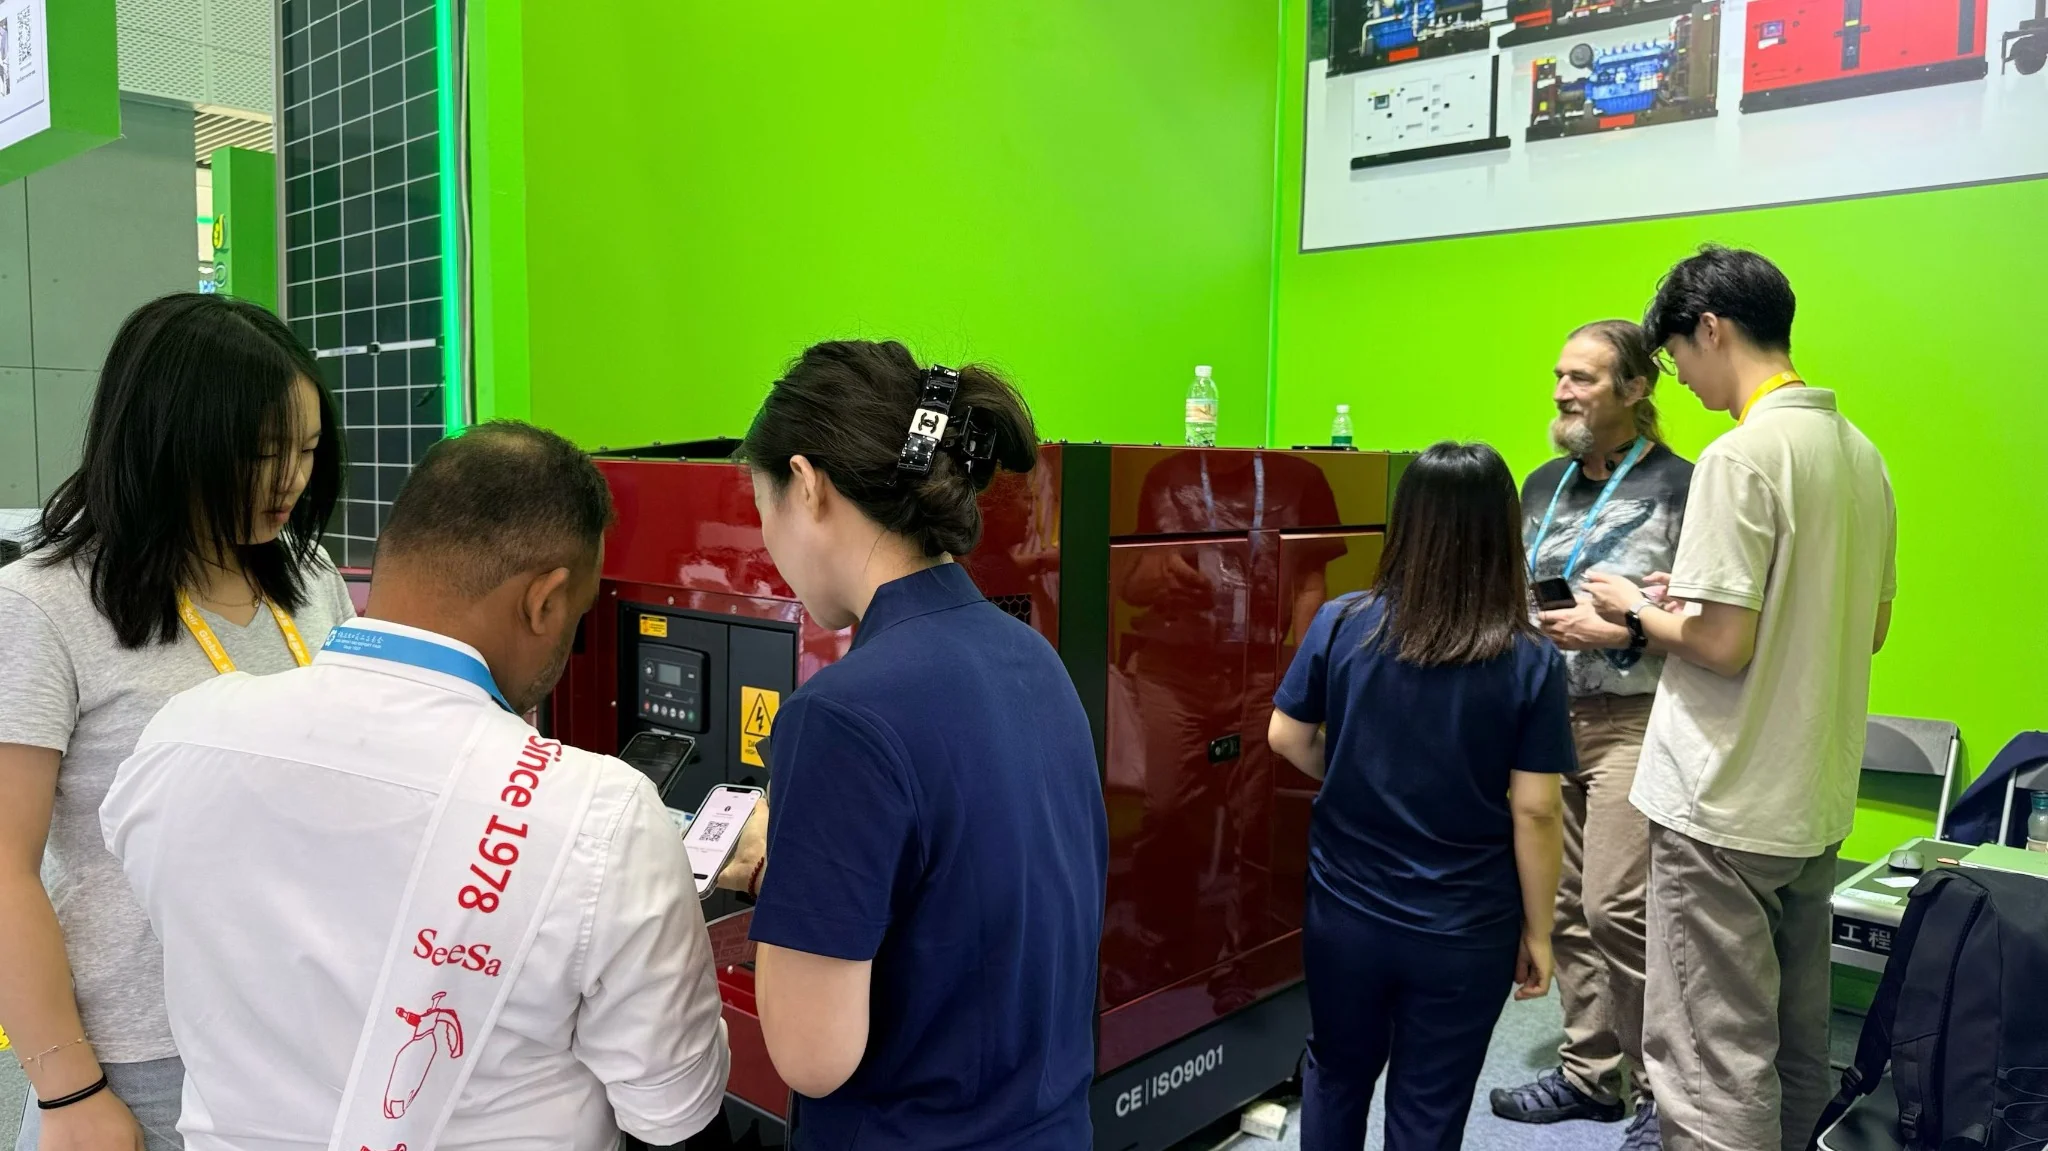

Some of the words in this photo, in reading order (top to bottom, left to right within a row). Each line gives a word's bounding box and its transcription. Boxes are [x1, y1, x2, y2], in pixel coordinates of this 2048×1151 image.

[199, 629, 221, 660] Global
[501, 735, 562, 808] Since
[458, 814, 529, 914] 1978
[413, 928, 501, 977] SeeSa
[1115, 1085, 1143, 1117] CE
[1152, 1044, 1223, 1098] ISO9001
